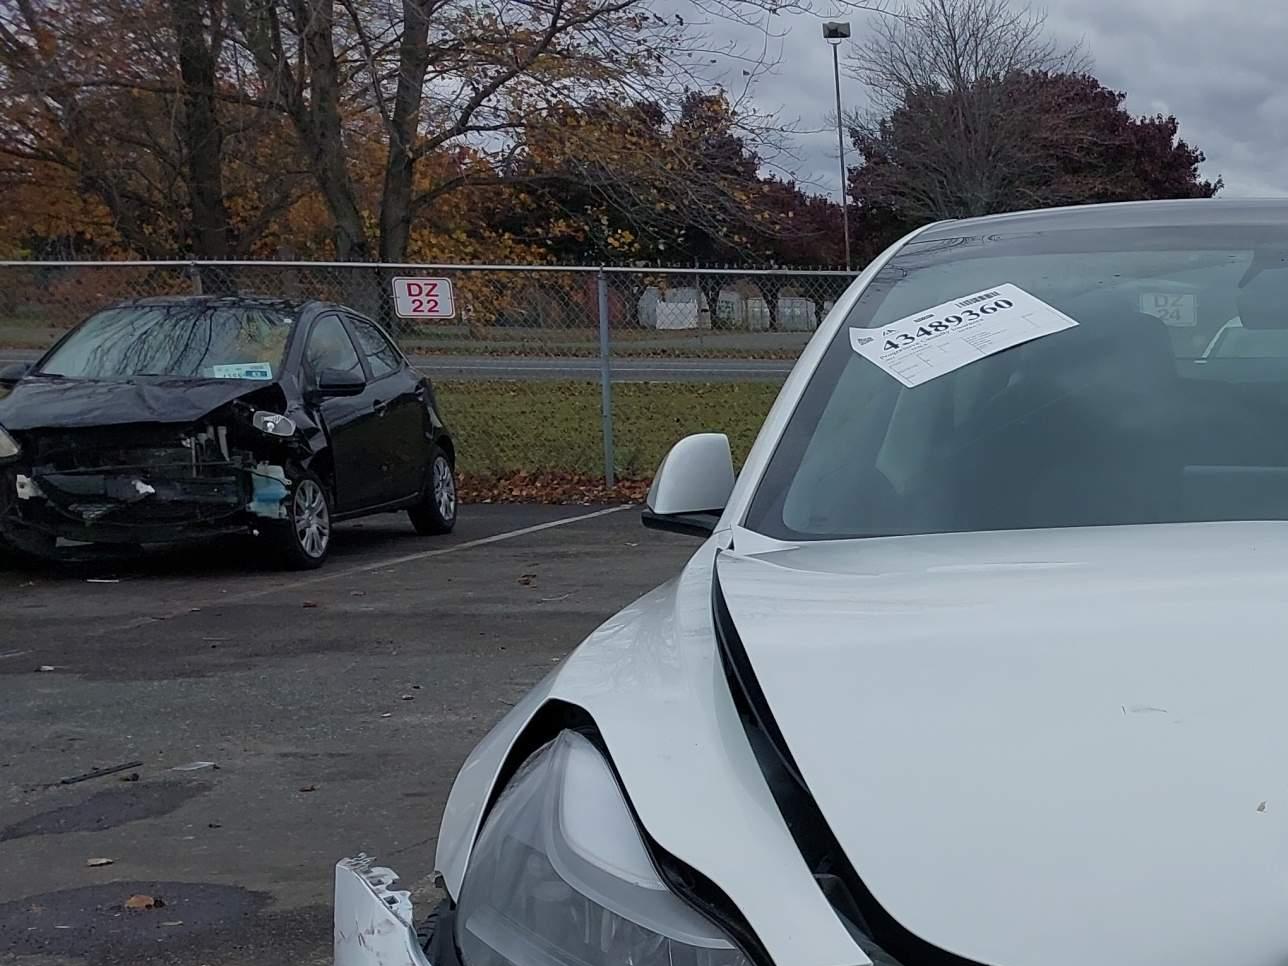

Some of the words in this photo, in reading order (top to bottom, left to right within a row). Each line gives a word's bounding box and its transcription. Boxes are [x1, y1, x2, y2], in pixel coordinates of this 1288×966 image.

[406, 282, 439, 297] DZ
[411, 299, 440, 313] 22
[1154, 295, 1184, 307] DZ
[883, 299, 1014, 351] 43489360
